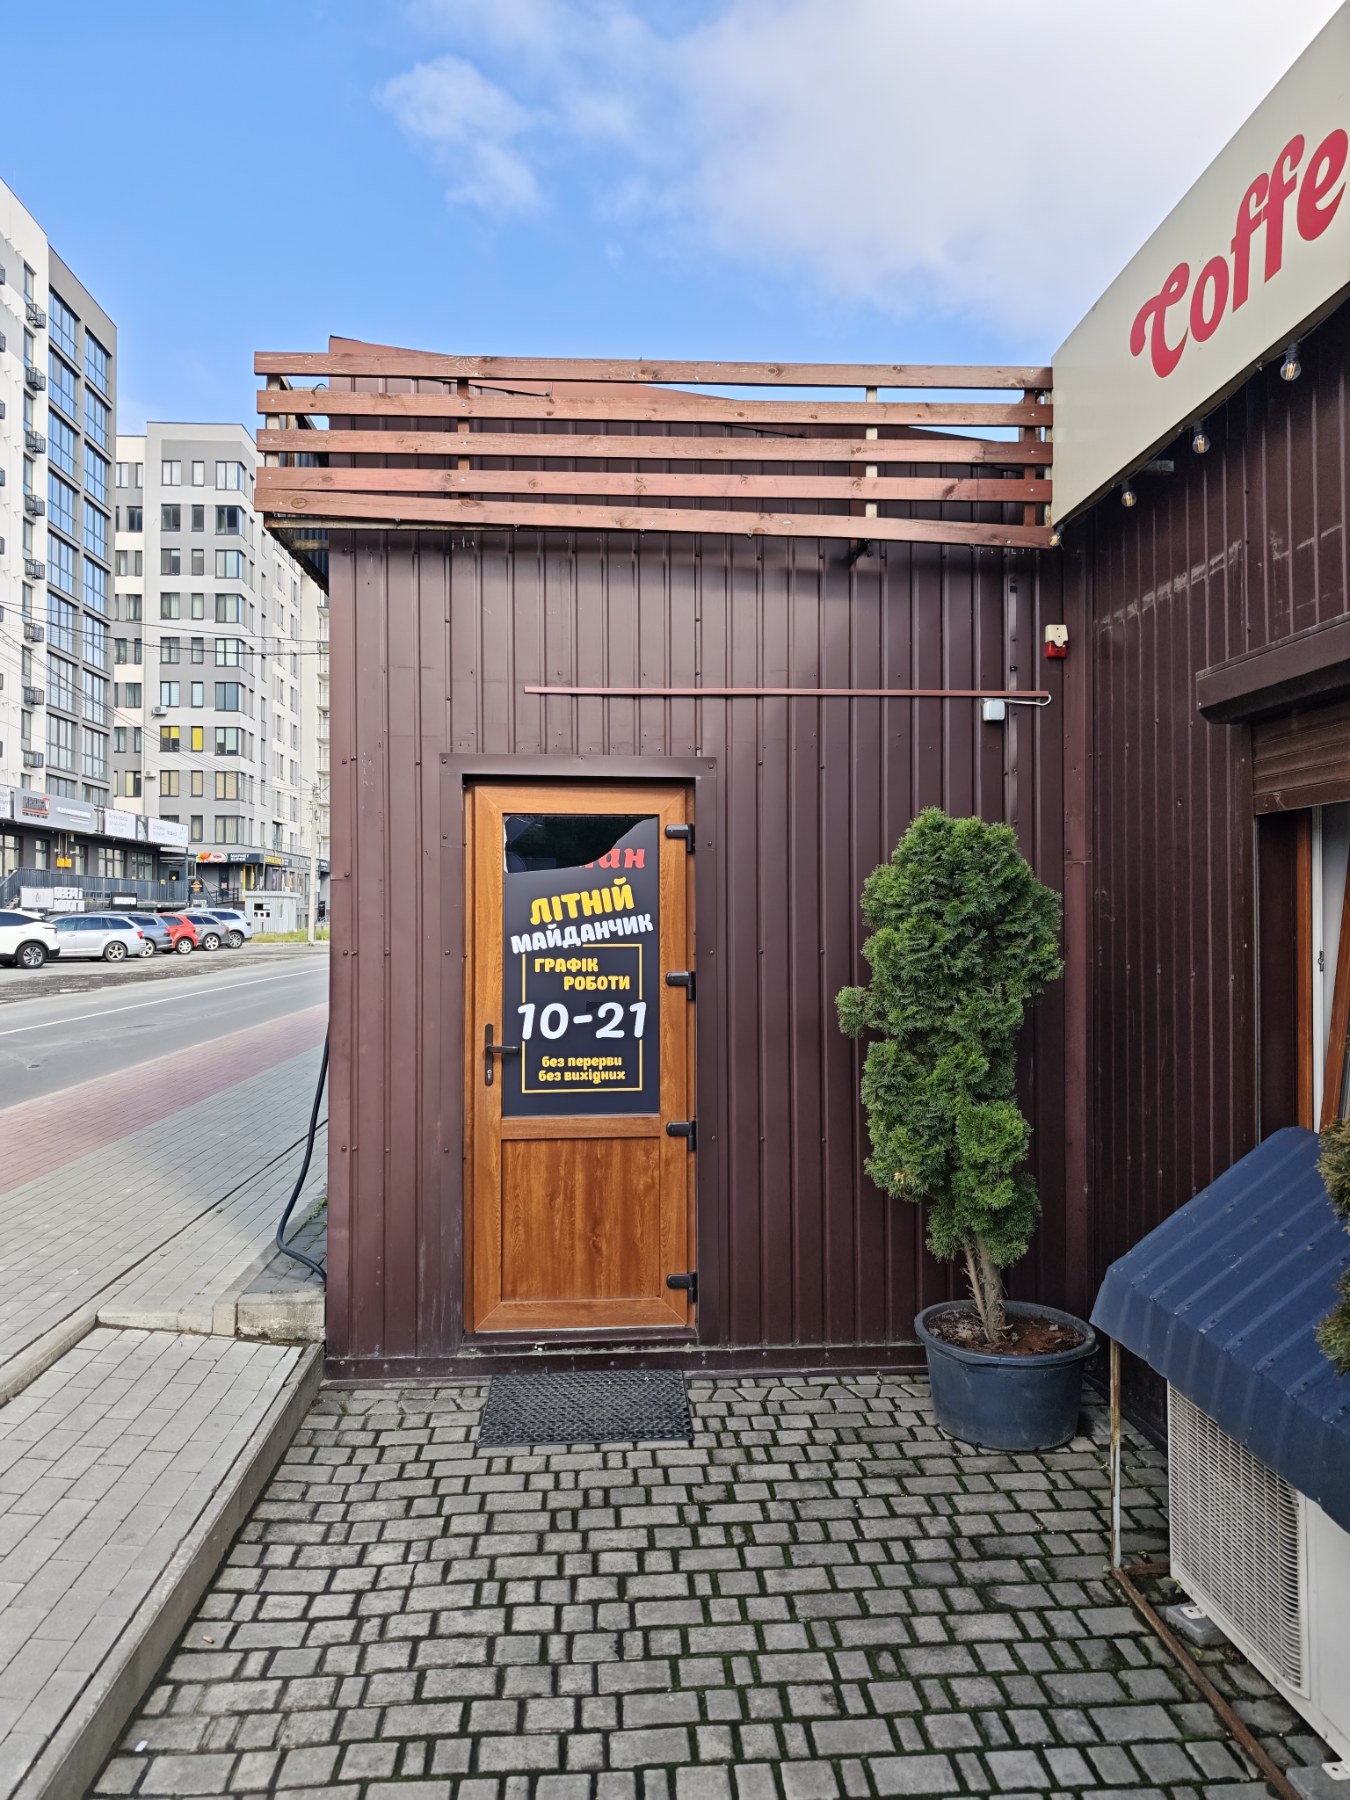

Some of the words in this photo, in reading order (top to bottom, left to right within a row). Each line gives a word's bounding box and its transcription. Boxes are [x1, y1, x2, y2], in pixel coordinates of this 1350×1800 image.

[1129, 128, 1349, 378] Coffe
[530, 877, 635, 926] ЛІТНІЙ
[510, 913, 654, 954] МАЙДАНЧИК
[534, 958, 599, 973] ГРАФІК
[563, 975, 631, 991] РОБОТИ
[517, 1002, 647, 1040] 10-21
[538, 1070, 562, 1082] без
[564, 1068, 626, 1084] вихідних
[541, 1056, 565, 1068] без
[567, 1057, 622, 1070] перерви
